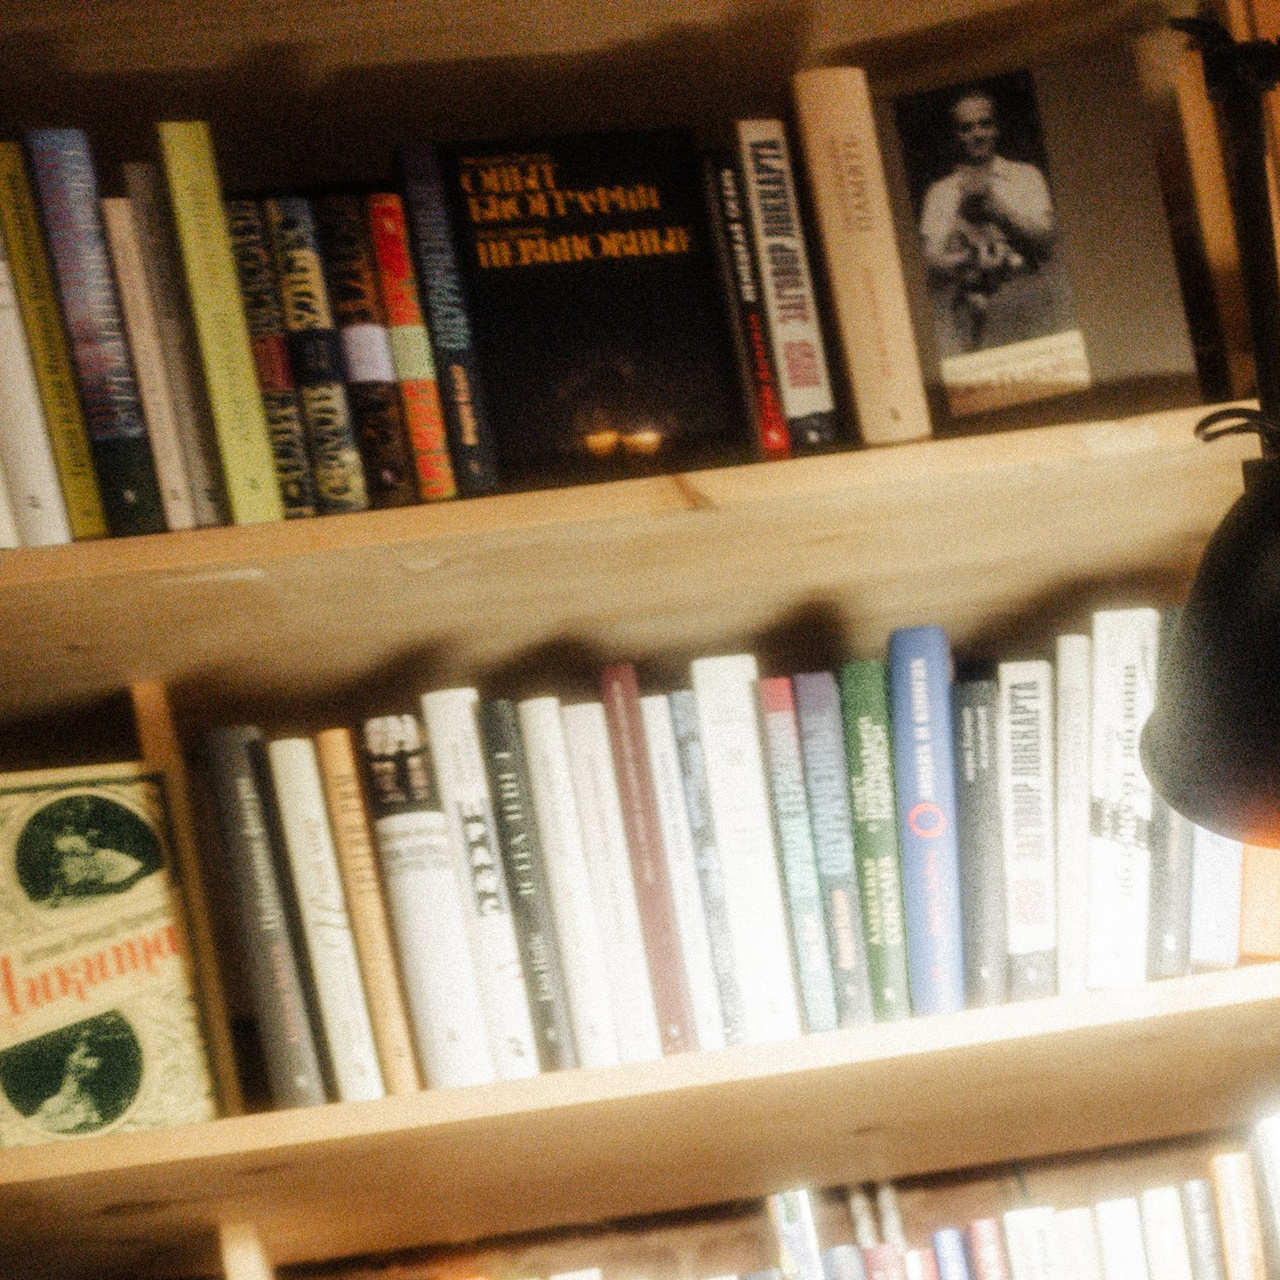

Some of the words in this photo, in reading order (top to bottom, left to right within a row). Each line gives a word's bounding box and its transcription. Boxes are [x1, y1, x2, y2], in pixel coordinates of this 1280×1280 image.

[749, 138, 793, 238] ЛОККАРТА
[768, 242, 810, 324] ЗАГОВОР
[1008, 680, 1041, 778] ЛОККАРТА
[805, 709, 854, 876] ОДУРАЧЕННЫЕ
[1011, 782, 1043, 859] ЗАГОВОР
